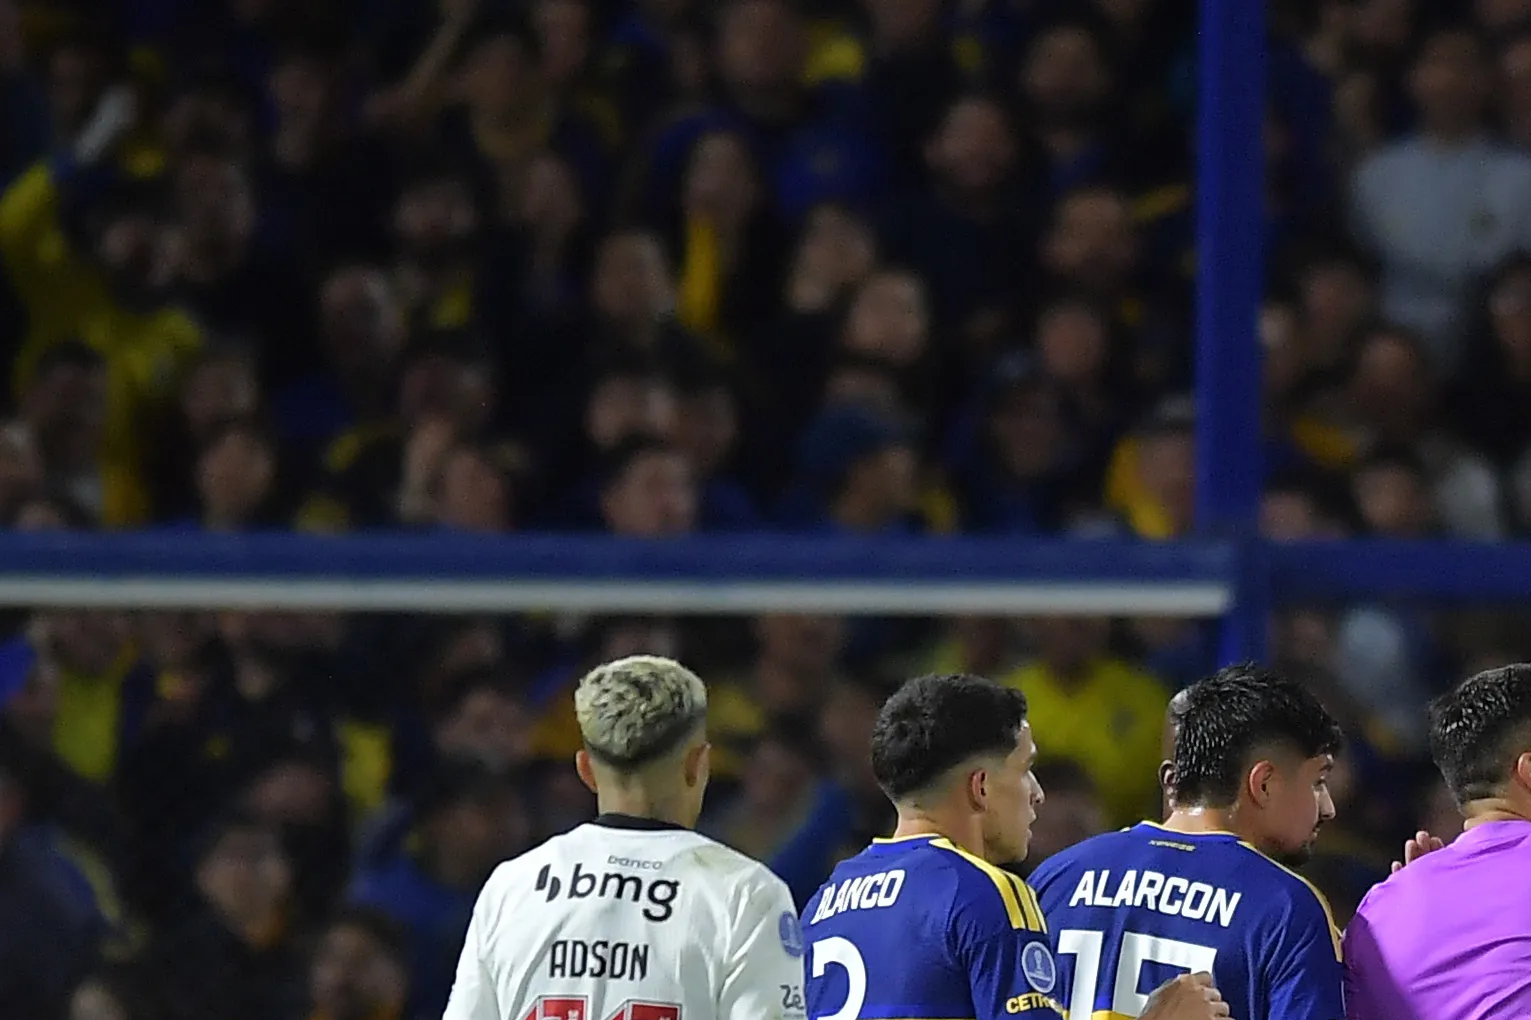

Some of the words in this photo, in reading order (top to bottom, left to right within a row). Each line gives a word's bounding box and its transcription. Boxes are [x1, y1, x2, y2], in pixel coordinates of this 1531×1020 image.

[567, 863, 681, 922] bmg
[810, 869, 906, 925] BLANCO
[1069, 870, 1241, 927] ALARCON
[549, 939, 649, 981] ADSON
